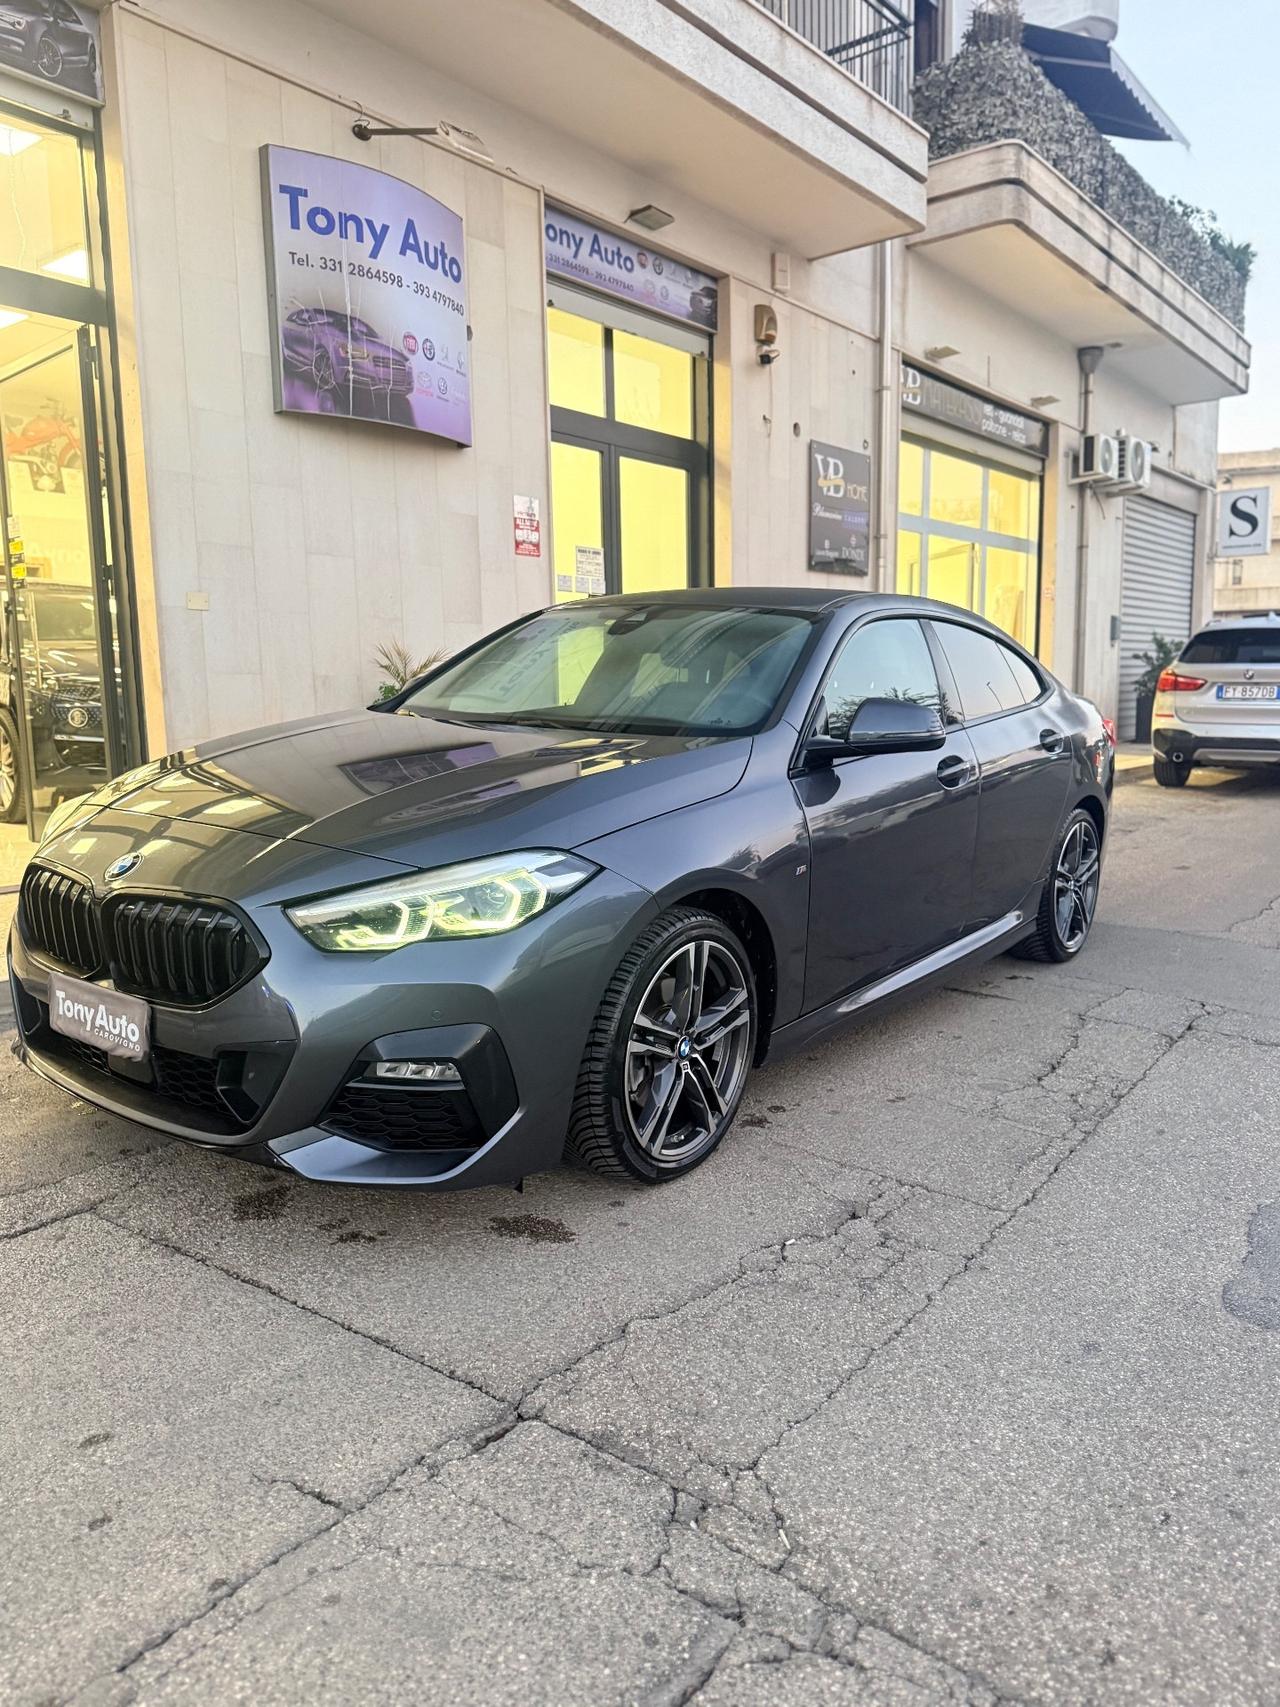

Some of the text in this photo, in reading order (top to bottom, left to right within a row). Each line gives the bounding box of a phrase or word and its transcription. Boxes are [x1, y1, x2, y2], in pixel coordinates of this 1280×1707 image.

[279, 184, 462, 284] Tony Auto
[545, 223, 635, 273] ony Auto
[288, 251, 315, 268] Tel.
[319, 256, 343, 273] 331
[348, 262, 403, 289] 2864598
[413, 281, 430, 299] 393
[432, 289, 465, 316] 4797840
[1229, 495, 1258, 539] S
[55, 989, 140, 1042] Tony Auto
[94, 1028, 140, 1052] CAROVIGNO
